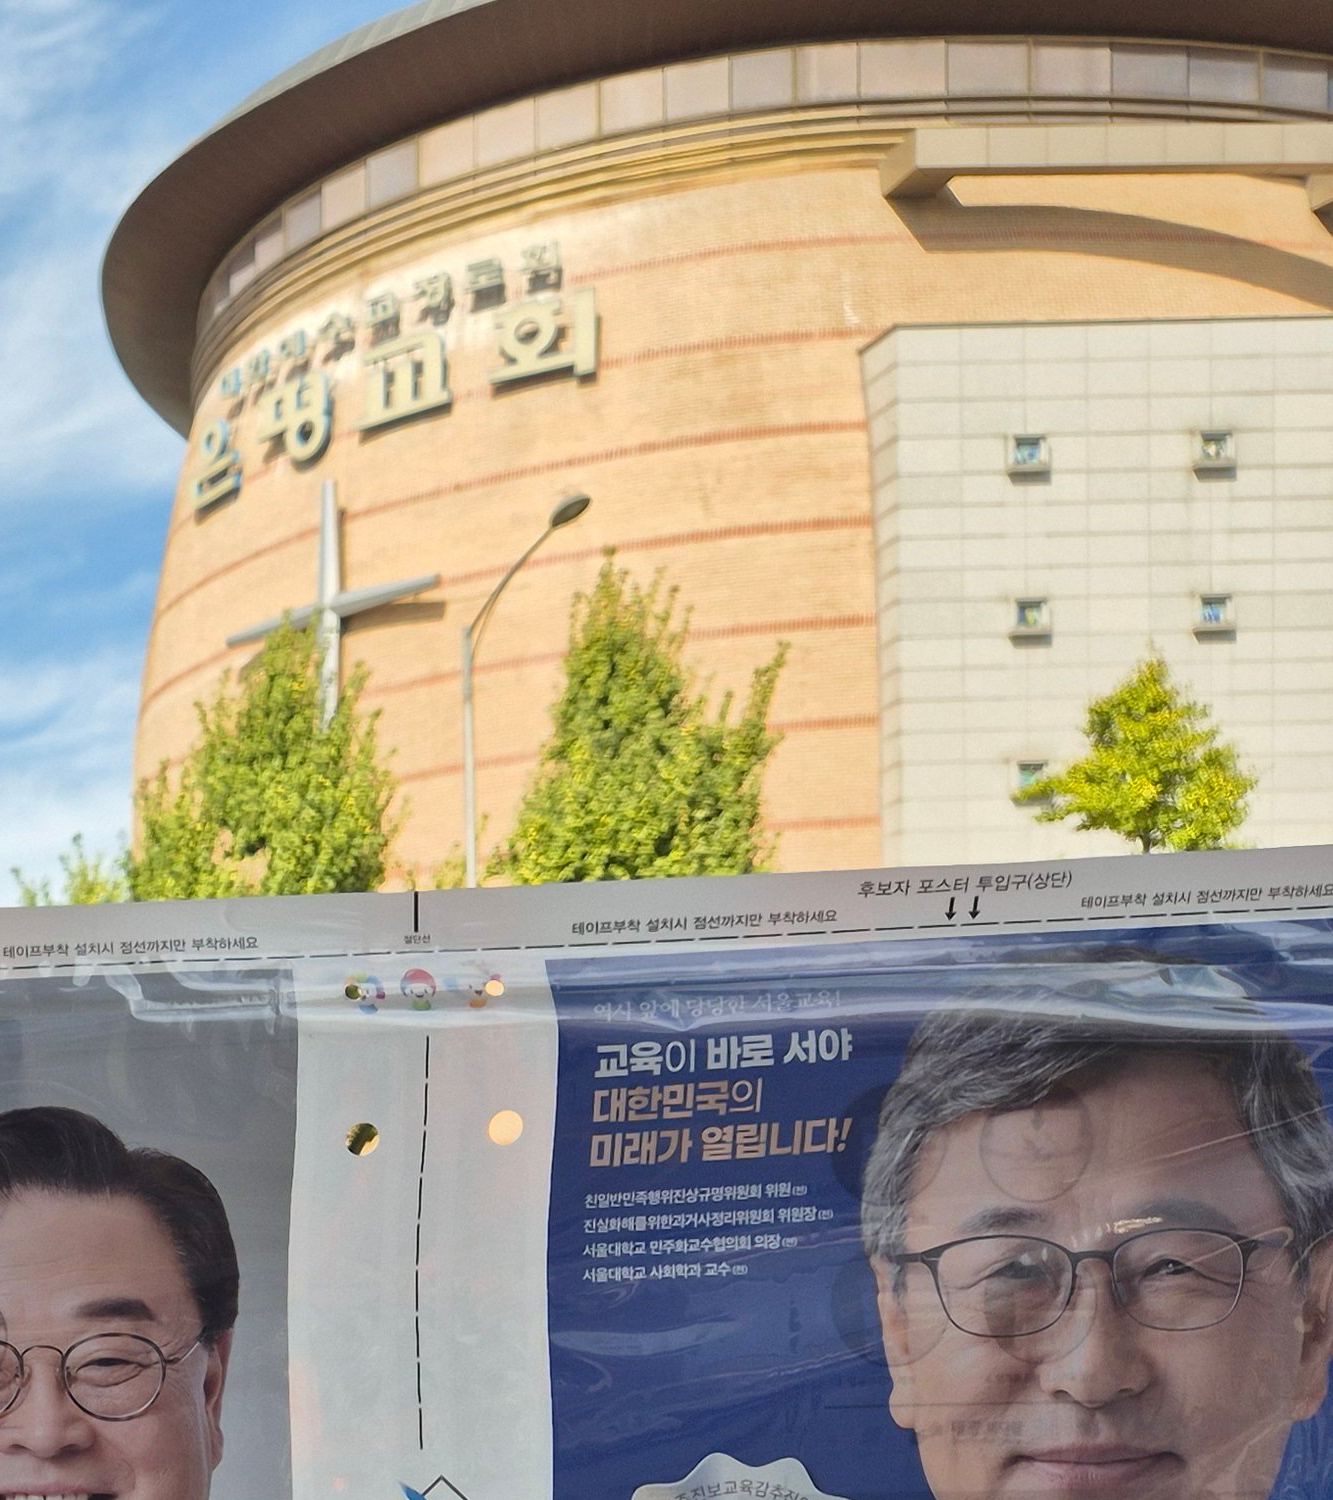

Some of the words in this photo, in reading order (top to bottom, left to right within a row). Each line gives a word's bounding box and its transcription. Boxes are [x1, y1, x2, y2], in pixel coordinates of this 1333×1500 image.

[193, 287, 598, 512] 은평교회
[858, 880, 910, 897] 후보자
[917, 877, 969, 893] 포스터
[976, 871, 1072, 892] 투입구(상단)
[1081, 893, 1146, 908] 테이프부착
[1153, 891, 1191, 906] 설치시
[1197, 888, 1262, 903] 점선까지만
[1268, 884, 1333, 899] 부착하세요
[572, 920, 640, 935] 테이프부착
[646, 917, 687, 932] 설치시
[694, 914, 762, 929] 점선까지만
[768, 910, 837, 925] 부착하세요
[3, 944, 69, 958] 테이프부착
[75, 942, 113, 955] 설치시
[120, 940, 185, 954] 점선까지만
[192, 937, 258, 951] 부착하세요
[594, 1039, 695, 1078] 교육이
[707, 1034, 775, 1070] 바로
[783, 1028, 853, 1064] 서야
[592, 1077, 763, 1122] 대한민국의
[589, 1128, 693, 1167] 미래가
[701, 1117, 853, 1161] 열립니다!
[582, 1242, 646, 1258] 서울대학교
[582, 1268, 646, 1283] 서울대학교
[649, 1263, 701, 1280] 사회학과
